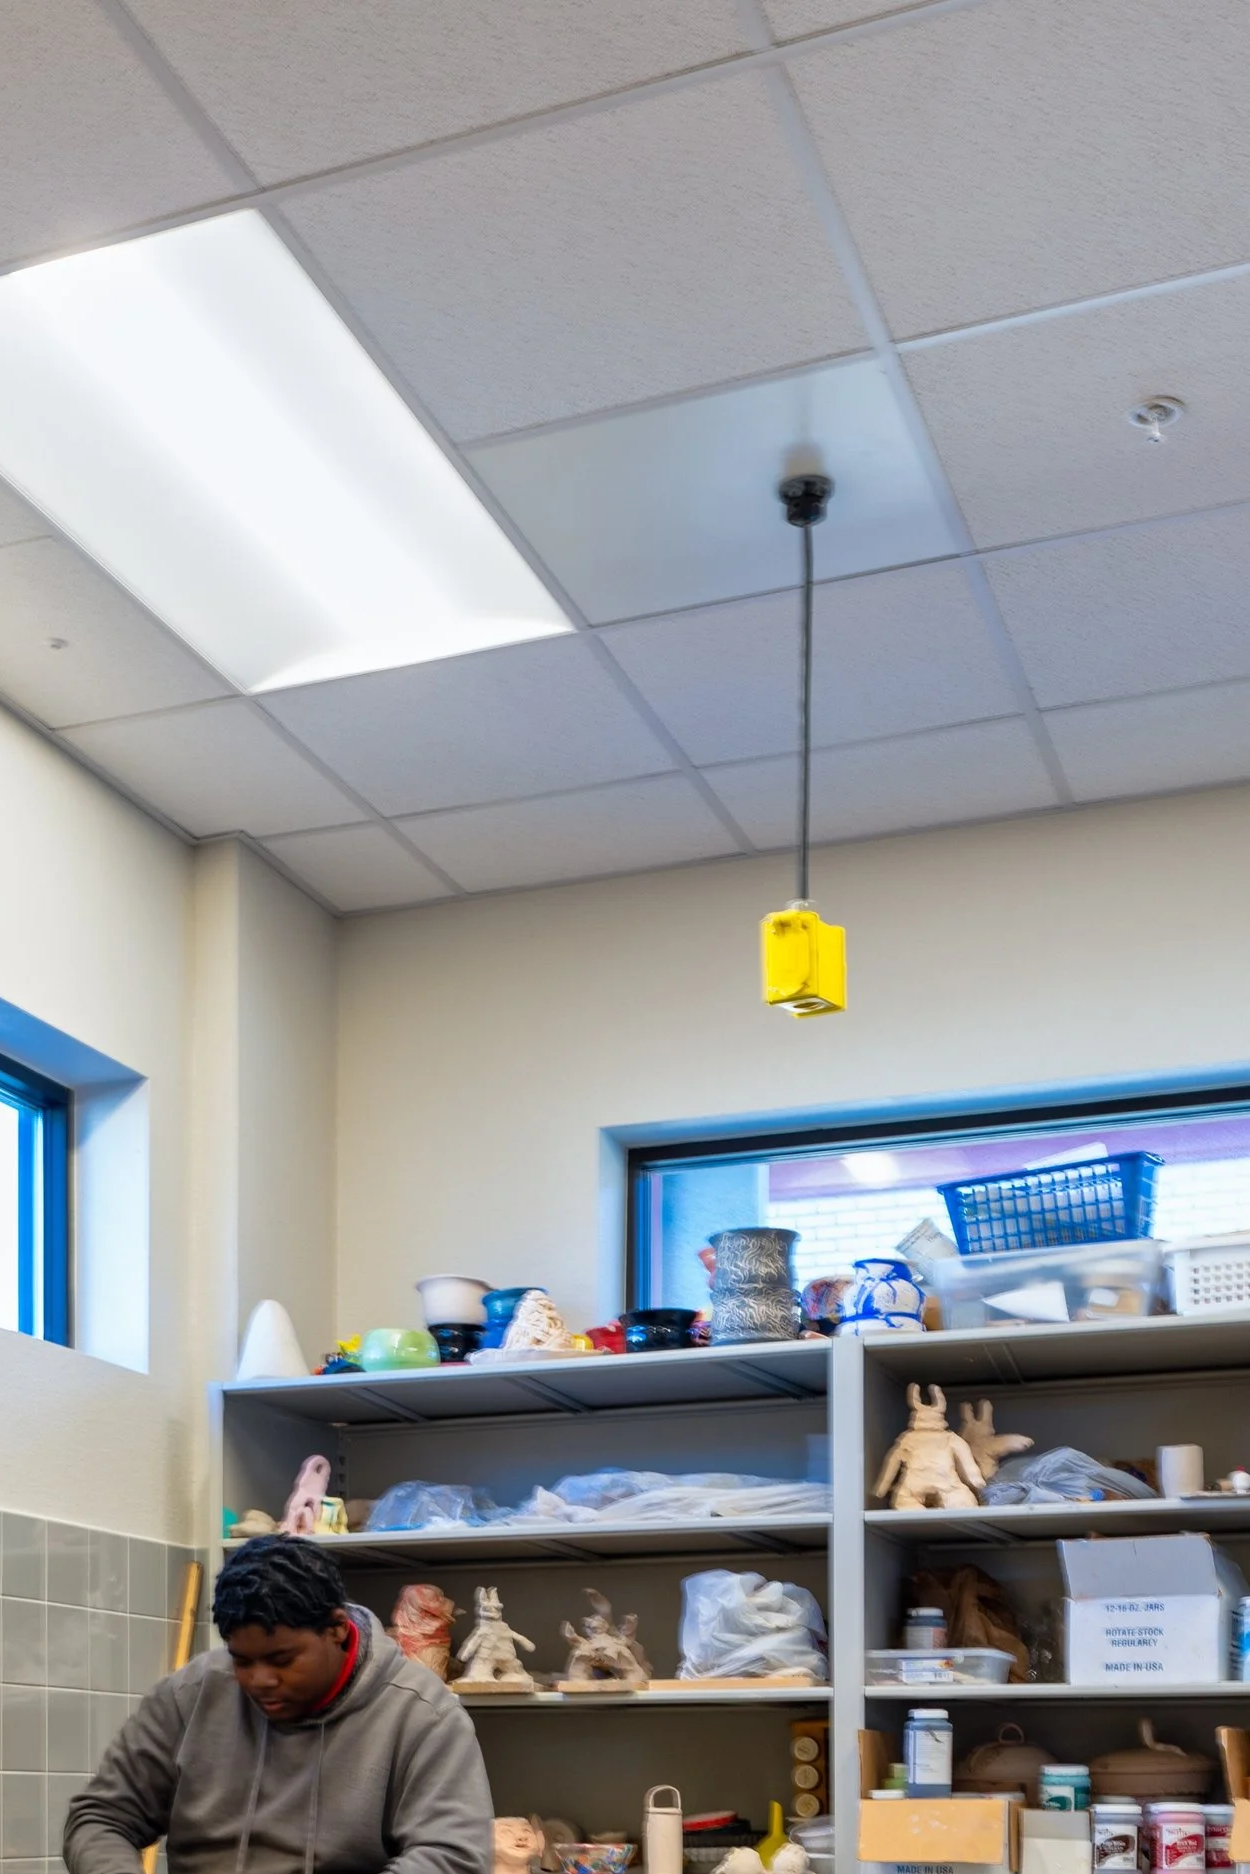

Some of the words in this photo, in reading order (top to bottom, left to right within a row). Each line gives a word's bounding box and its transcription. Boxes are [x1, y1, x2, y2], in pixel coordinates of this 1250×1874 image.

[1144, 1602, 1165, 1611] JARS
[1105, 1628, 1135, 1637] ROTATE
[1137, 1627, 1164, 1636] STOCK
[1111, 1638, 1158, 1647] REGULARLY
[1105, 1662, 1131, 1672] MADE
[1133, 1662, 1143, 1671] IN
[1145, 1662, 1164, 1671] USA
[897, 1864, 921, 1874] MADE
[924, 1864, 934, 1874] IN
[936, 1864, 954, 1874] USA
